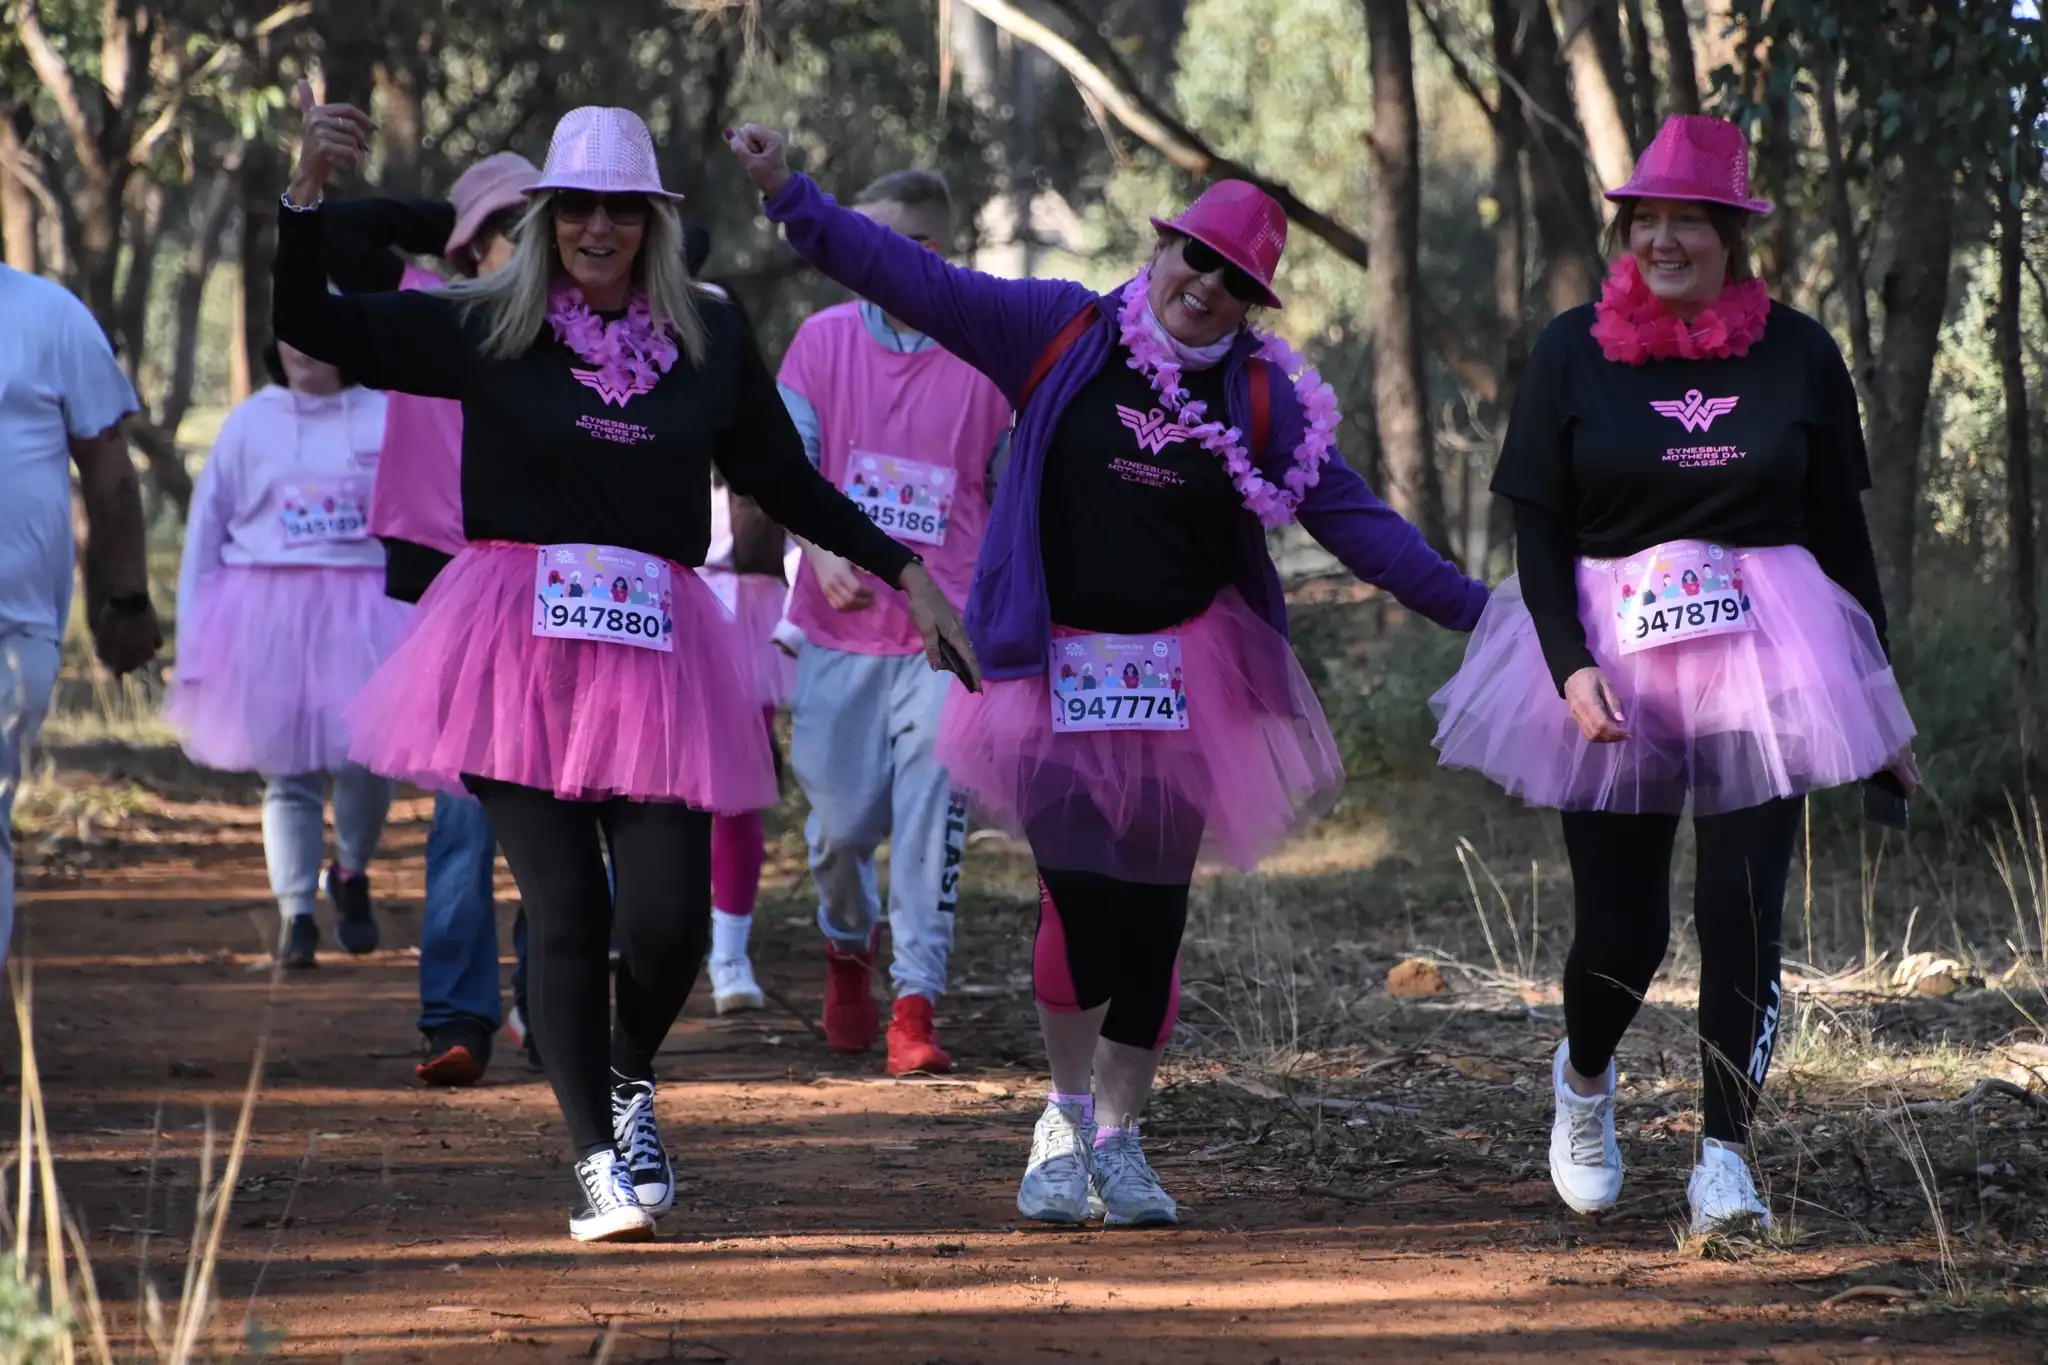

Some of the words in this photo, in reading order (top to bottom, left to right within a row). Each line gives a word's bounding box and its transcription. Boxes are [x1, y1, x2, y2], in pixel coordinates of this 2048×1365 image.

[575, 420, 629, 437] MOTHERS
[632, 431, 656, 441] DAY
[581, 414, 648, 432] EYNESBURY
[590, 430, 637, 445] CLASSIC
[1661, 452, 1719, 462] MOTHERS
[1722, 451, 1747, 459] DAY
[1666, 446, 1737, 455] EYNESBURY
[1114, 457, 1179, 477] EYNESBURY
[1679, 459, 1728, 468] CLASSIC
[1107, 463, 1160, 480] MOTHERS
[1162, 475, 1186, 487] DAY
[1121, 473, 1166, 489] CLASSIC
[551, 604, 660, 638] 947880
[1636, 598, 1739, 639] 947879
[1067, 695, 1174, 721] 947774
[1747, 980, 1781, 1084] 2XU
